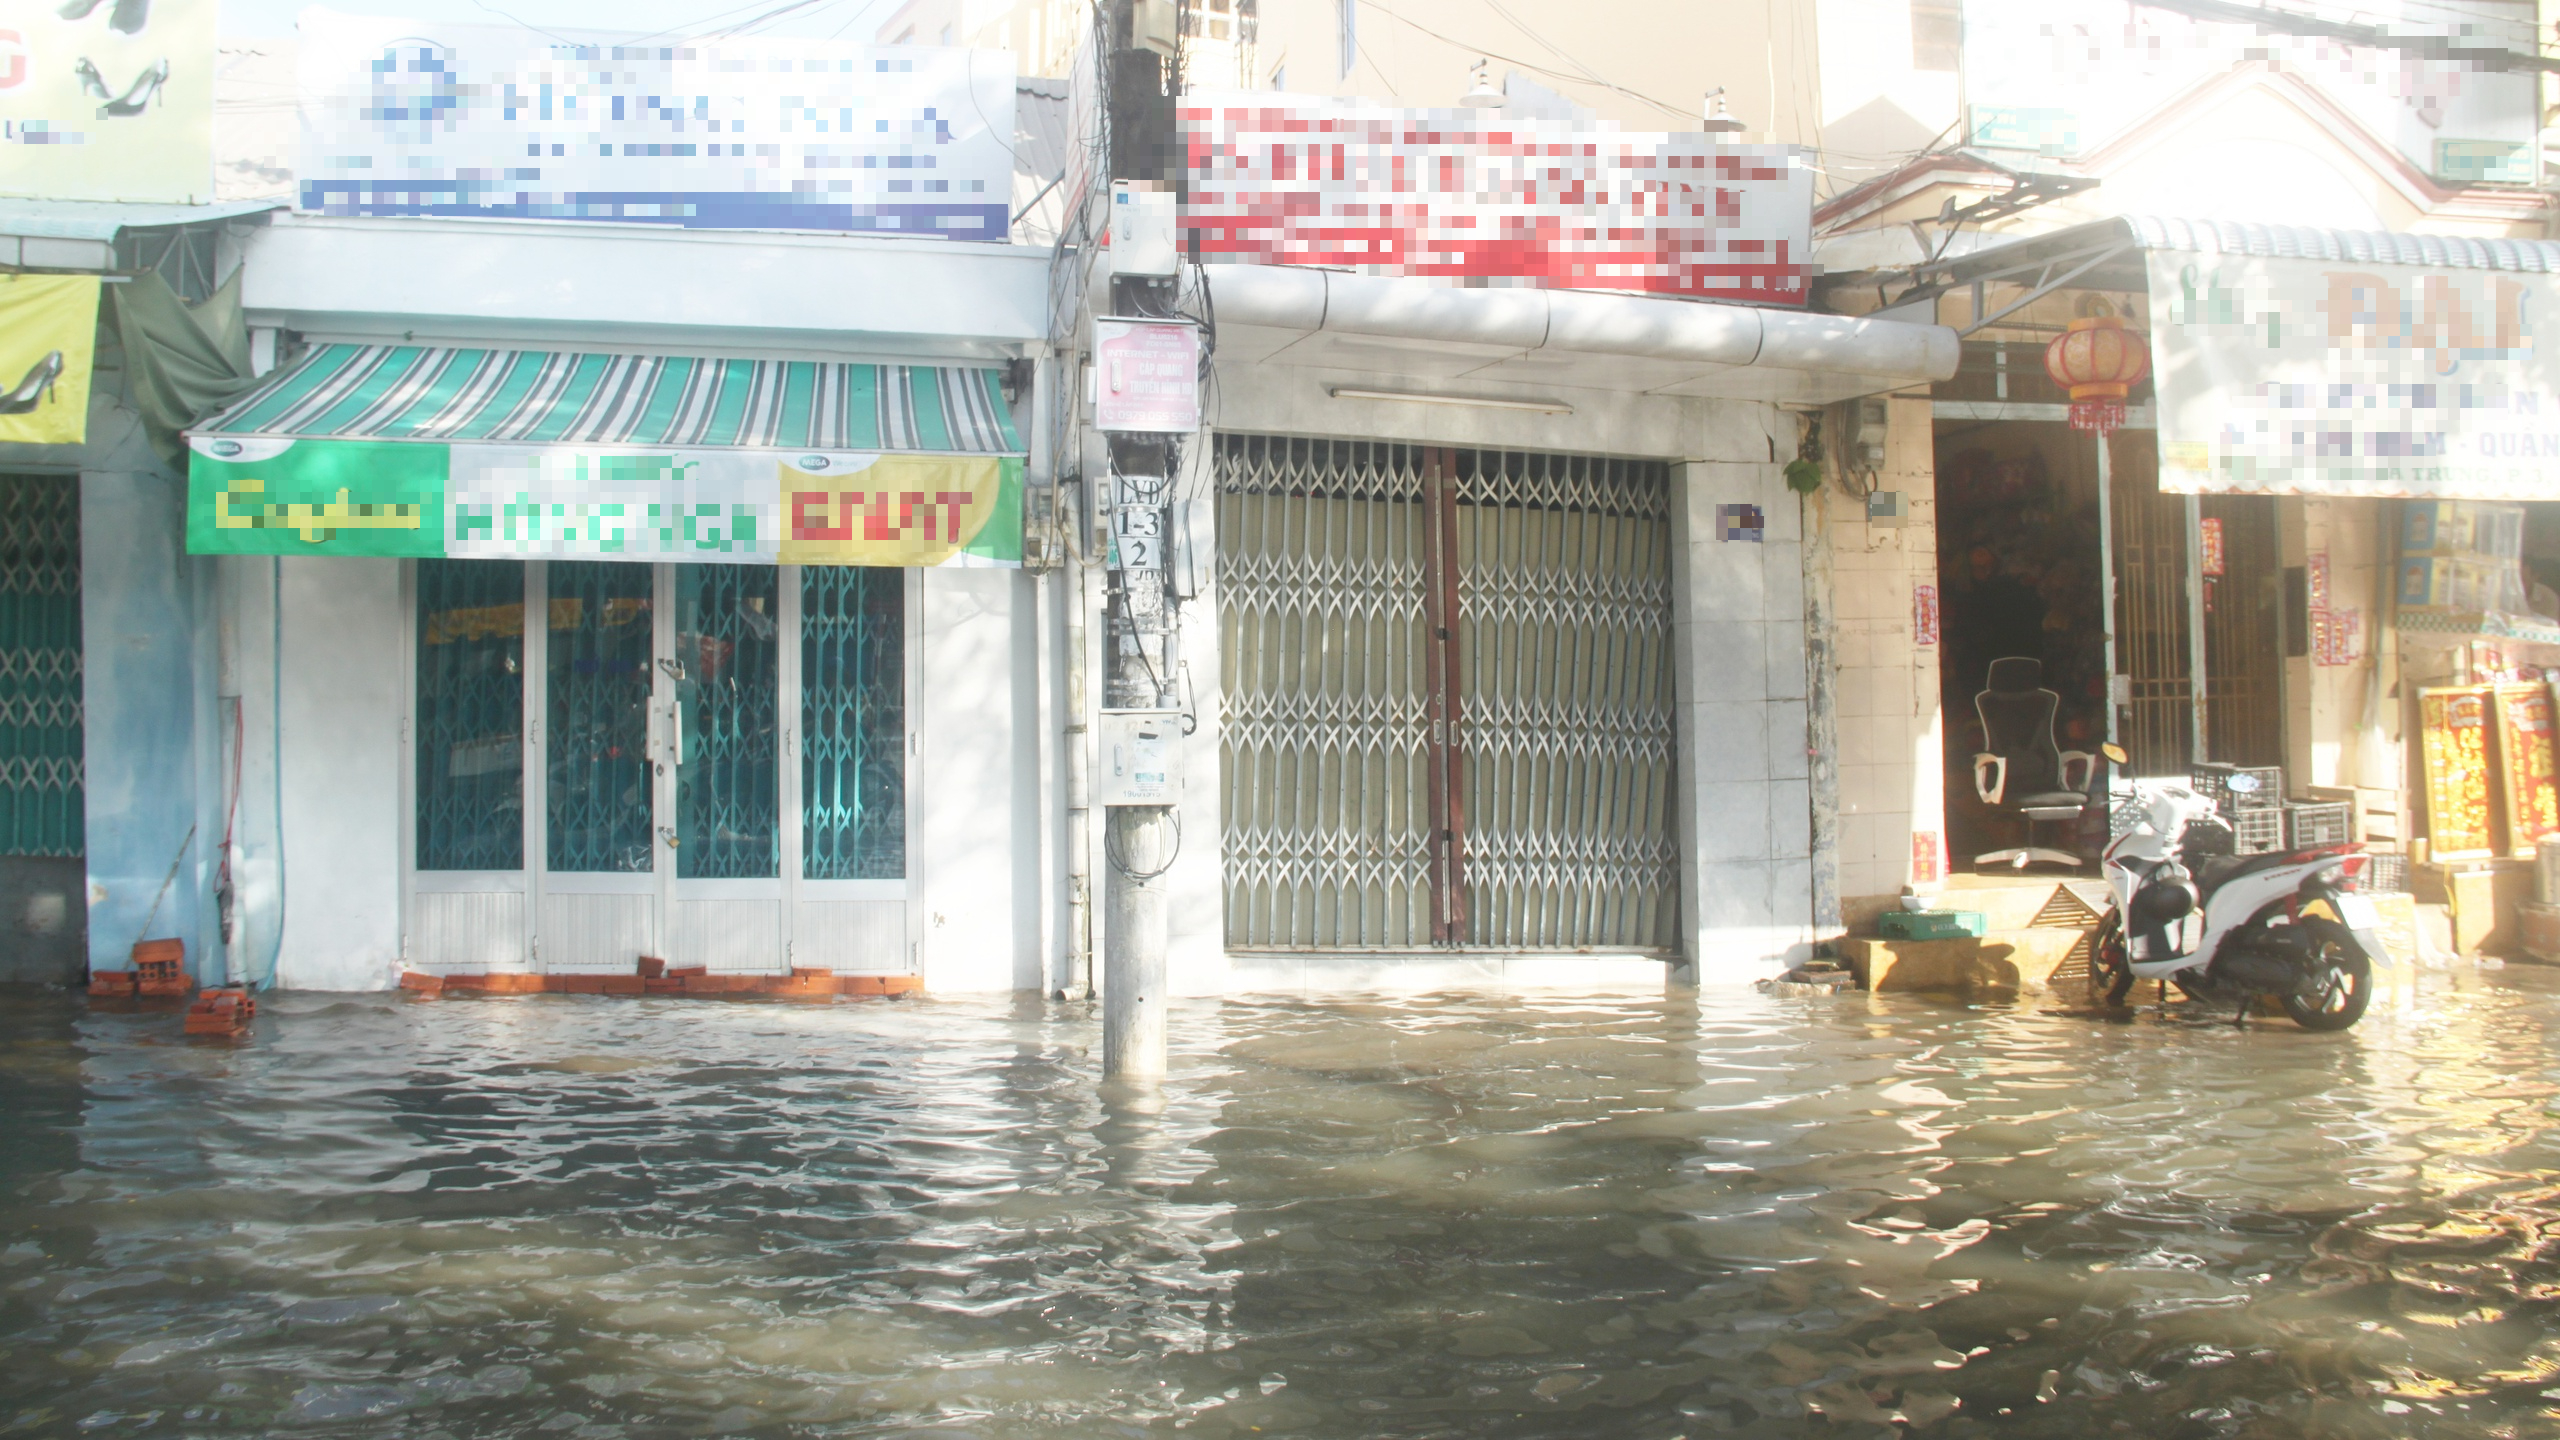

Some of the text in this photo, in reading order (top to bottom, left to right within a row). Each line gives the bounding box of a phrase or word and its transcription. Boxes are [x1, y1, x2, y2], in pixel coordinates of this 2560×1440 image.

[1107, 348, 1189, 360] INTERNET WIFI
[1157, 363, 1184, 377] QUANG
[1118, 411, 1193, 423] 0979 055 550
[802, 458, 827, 467] MEGA
[1120, 480, 1160, 505] LVD
[1119, 511, 1159, 536] 1-3
[1130, 541, 1147, 566] 2
